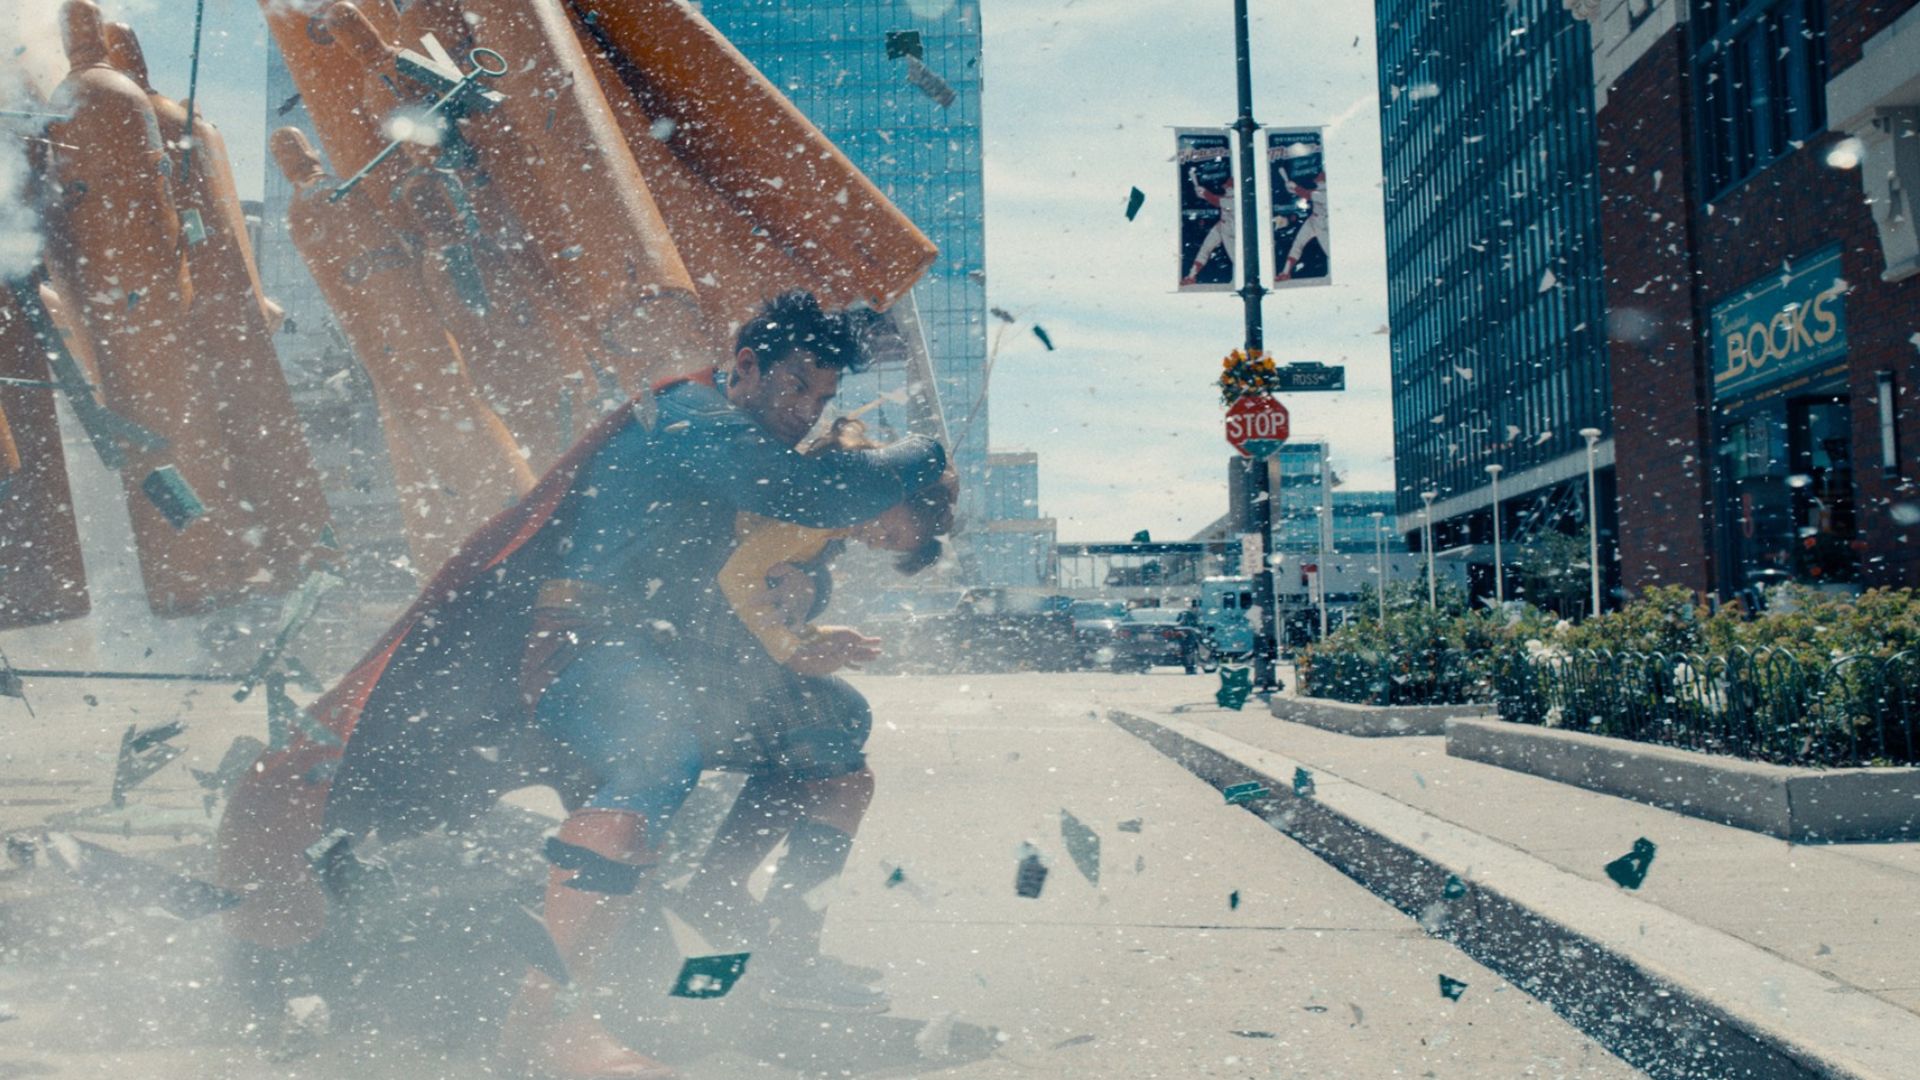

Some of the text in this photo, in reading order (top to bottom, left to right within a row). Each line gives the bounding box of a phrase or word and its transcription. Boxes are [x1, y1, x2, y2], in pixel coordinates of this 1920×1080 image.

[1714, 284, 1843, 384] BOOKS
[1292, 374, 1319, 385] ROSS
[1230, 412, 1285, 438] STOP
